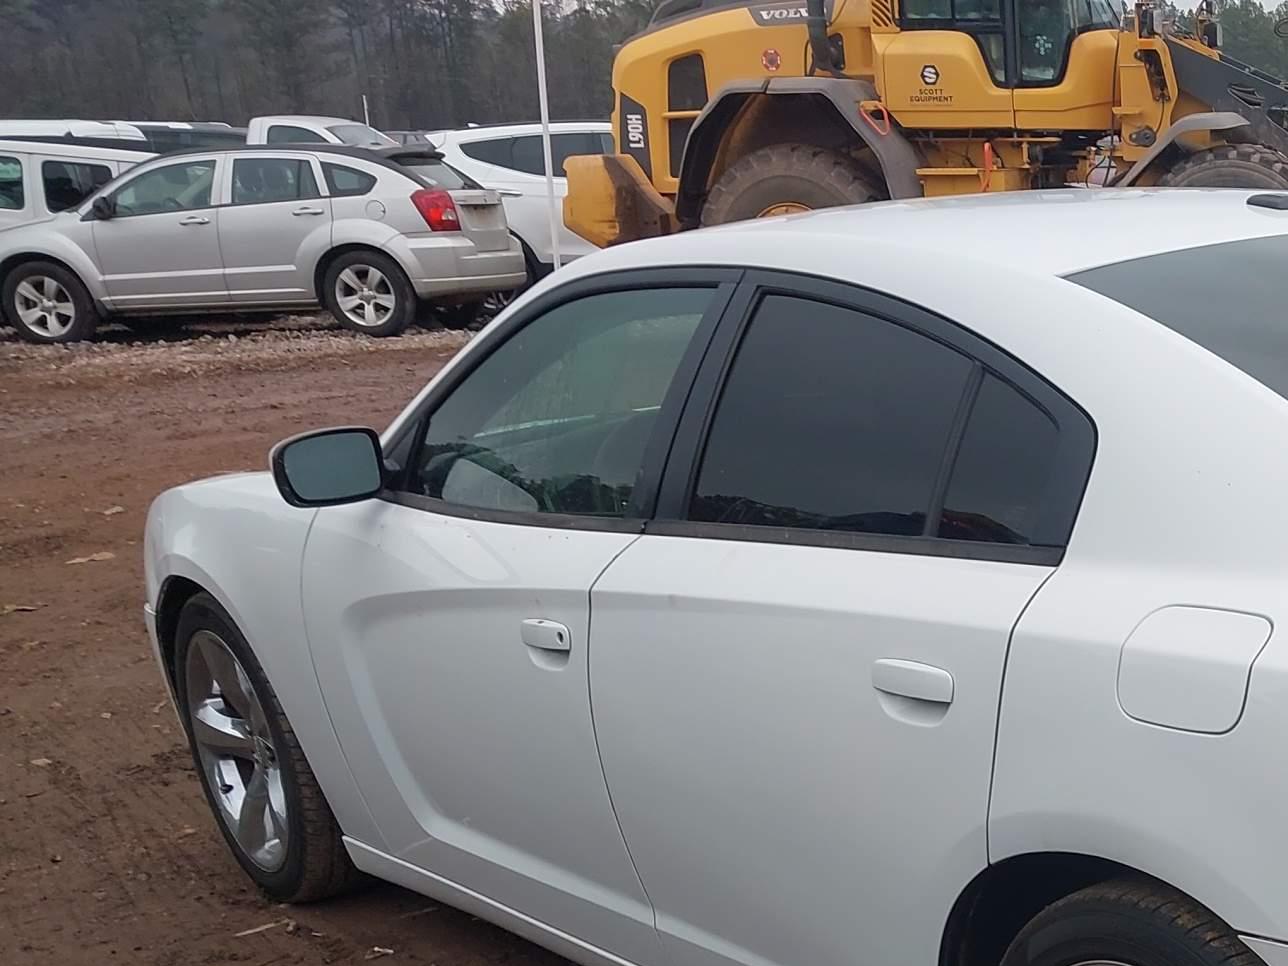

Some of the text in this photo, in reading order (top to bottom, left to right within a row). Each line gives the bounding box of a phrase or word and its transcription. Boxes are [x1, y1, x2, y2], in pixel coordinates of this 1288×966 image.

[760, 8, 827, 20] VOLV
[910, 95, 953, 103] EQUIPMENT
[626, 114, 645, 148] L90H
